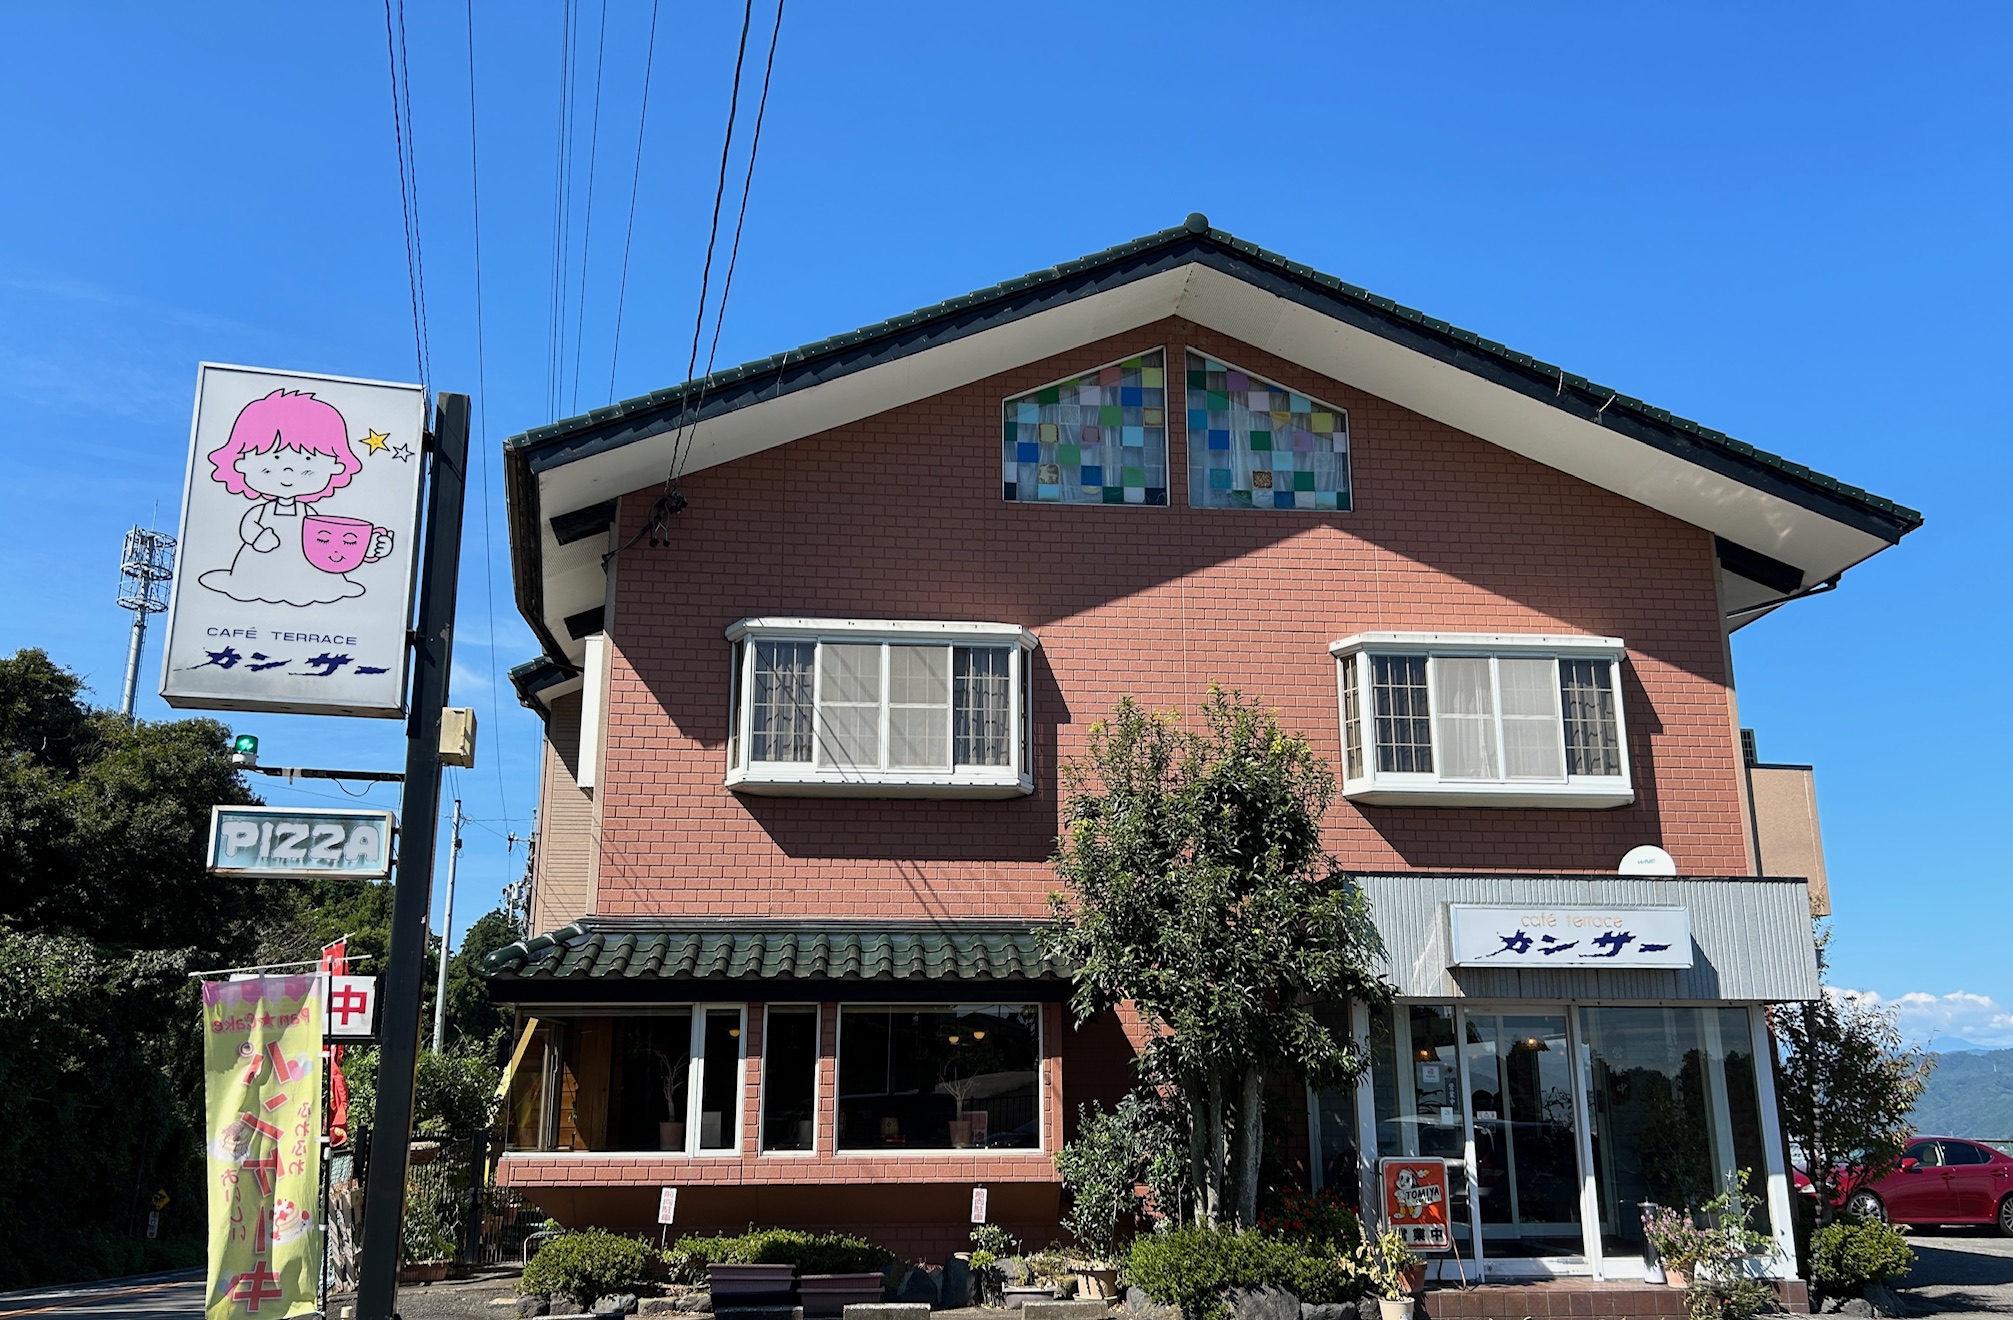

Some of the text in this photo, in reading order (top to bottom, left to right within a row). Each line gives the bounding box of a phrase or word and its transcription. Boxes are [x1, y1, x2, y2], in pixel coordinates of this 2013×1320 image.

[206, 627, 357, 645] CAFÉ TERRACE
[173, 646, 391, 677] カンサー
[221, 820, 381, 864] PIZZA
[1521, 913, 1623, 928] café terrace
[1475, 929, 1672, 960] カンサー
[1406, 1187, 1440, 1200] TOMIYA
